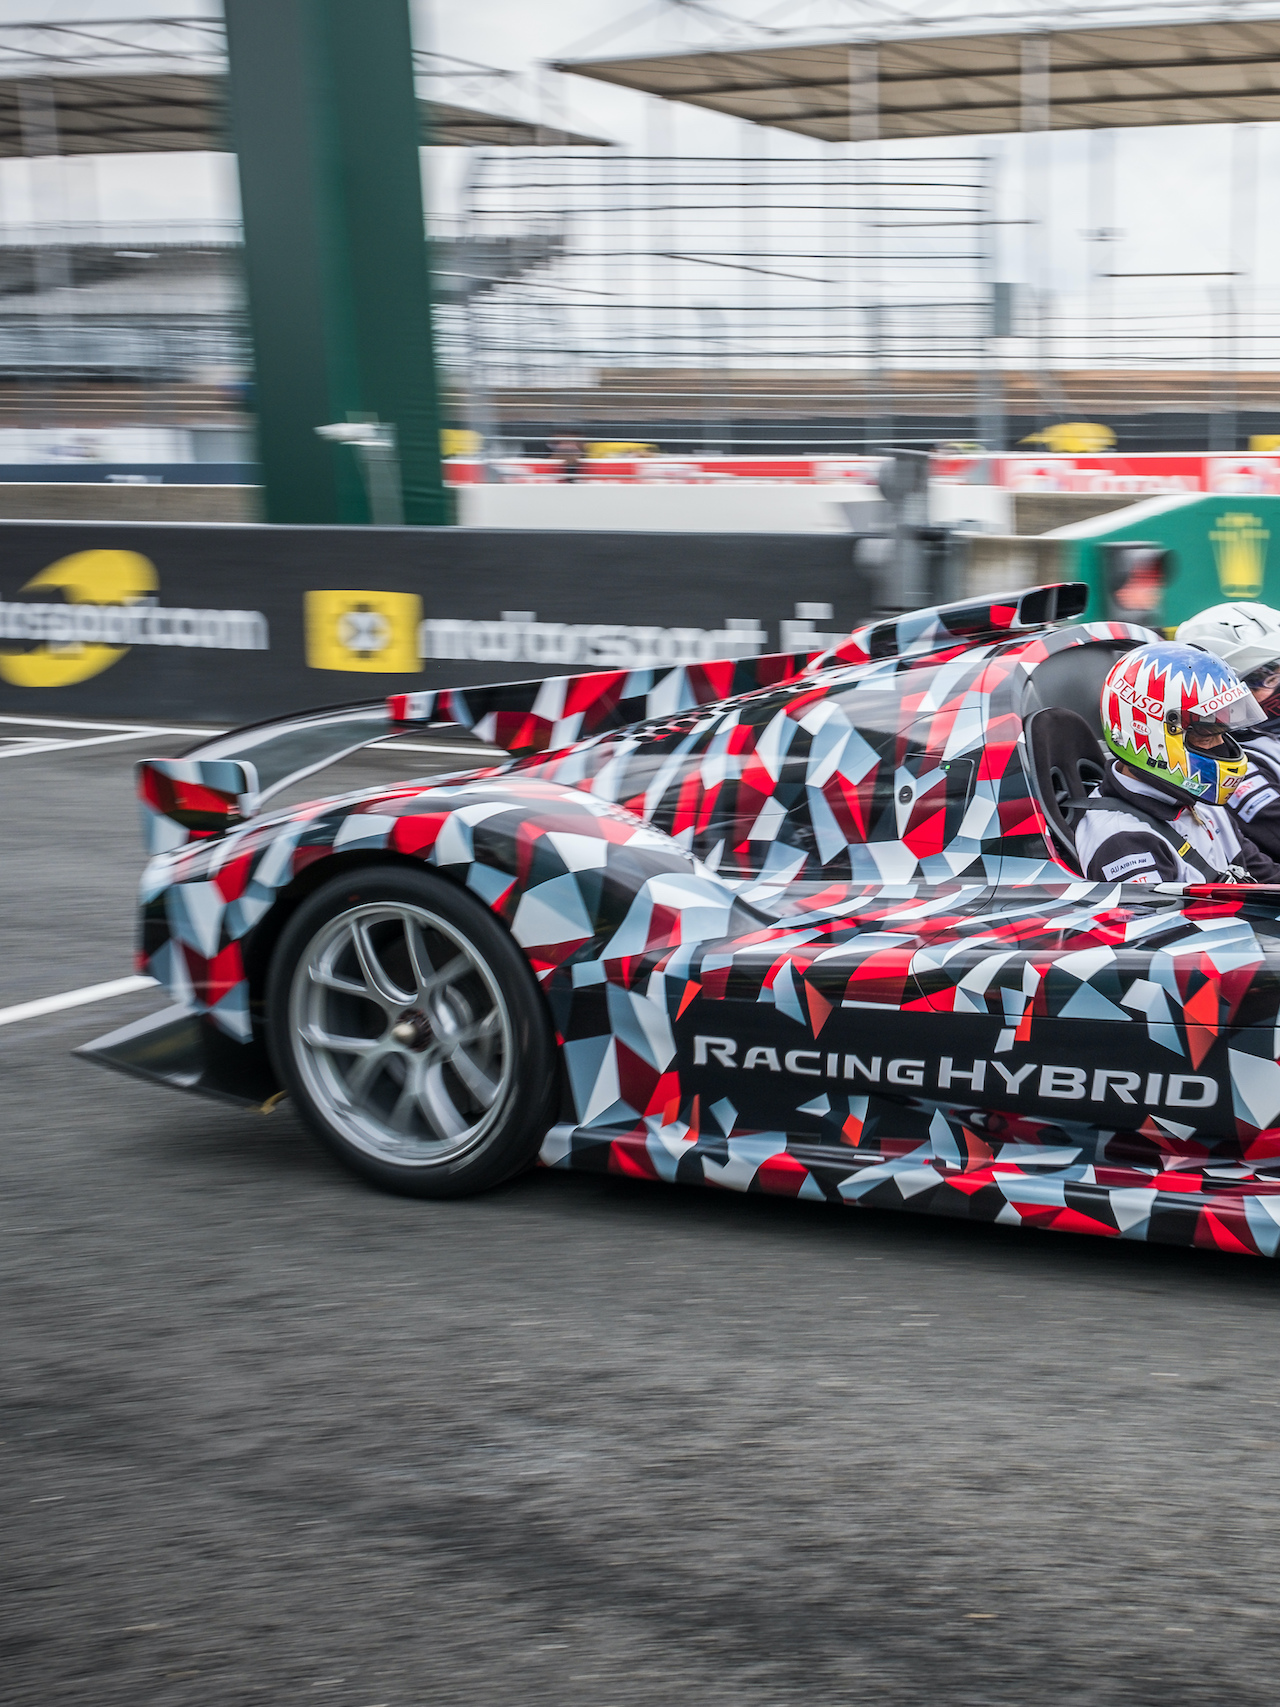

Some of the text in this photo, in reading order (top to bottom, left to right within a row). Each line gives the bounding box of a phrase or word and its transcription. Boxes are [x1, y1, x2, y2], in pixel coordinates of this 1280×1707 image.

[1113, 677, 1163, 715] DENSO
[1200, 687, 1244, 714] TOYOTA
[1132, 721, 1149, 734] BELL
[692, 1034, 1220, 1108] RACING HYBRID
